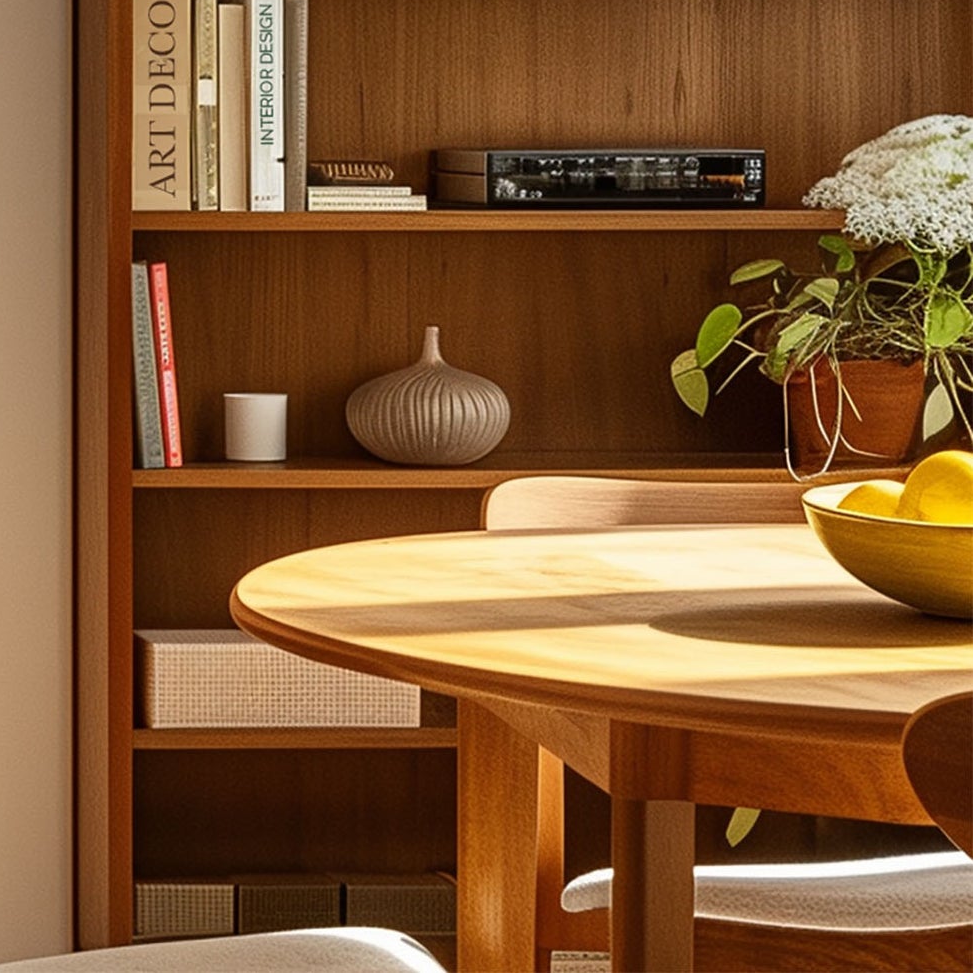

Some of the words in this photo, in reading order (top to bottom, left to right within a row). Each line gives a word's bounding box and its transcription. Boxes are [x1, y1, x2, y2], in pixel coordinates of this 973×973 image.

[147, 0, 176, 111] DECO
[258, 3, 274, 65] DESIGN
[259, 67, 274, 146] INTERIOR
[148, 120, 176, 198] ART
